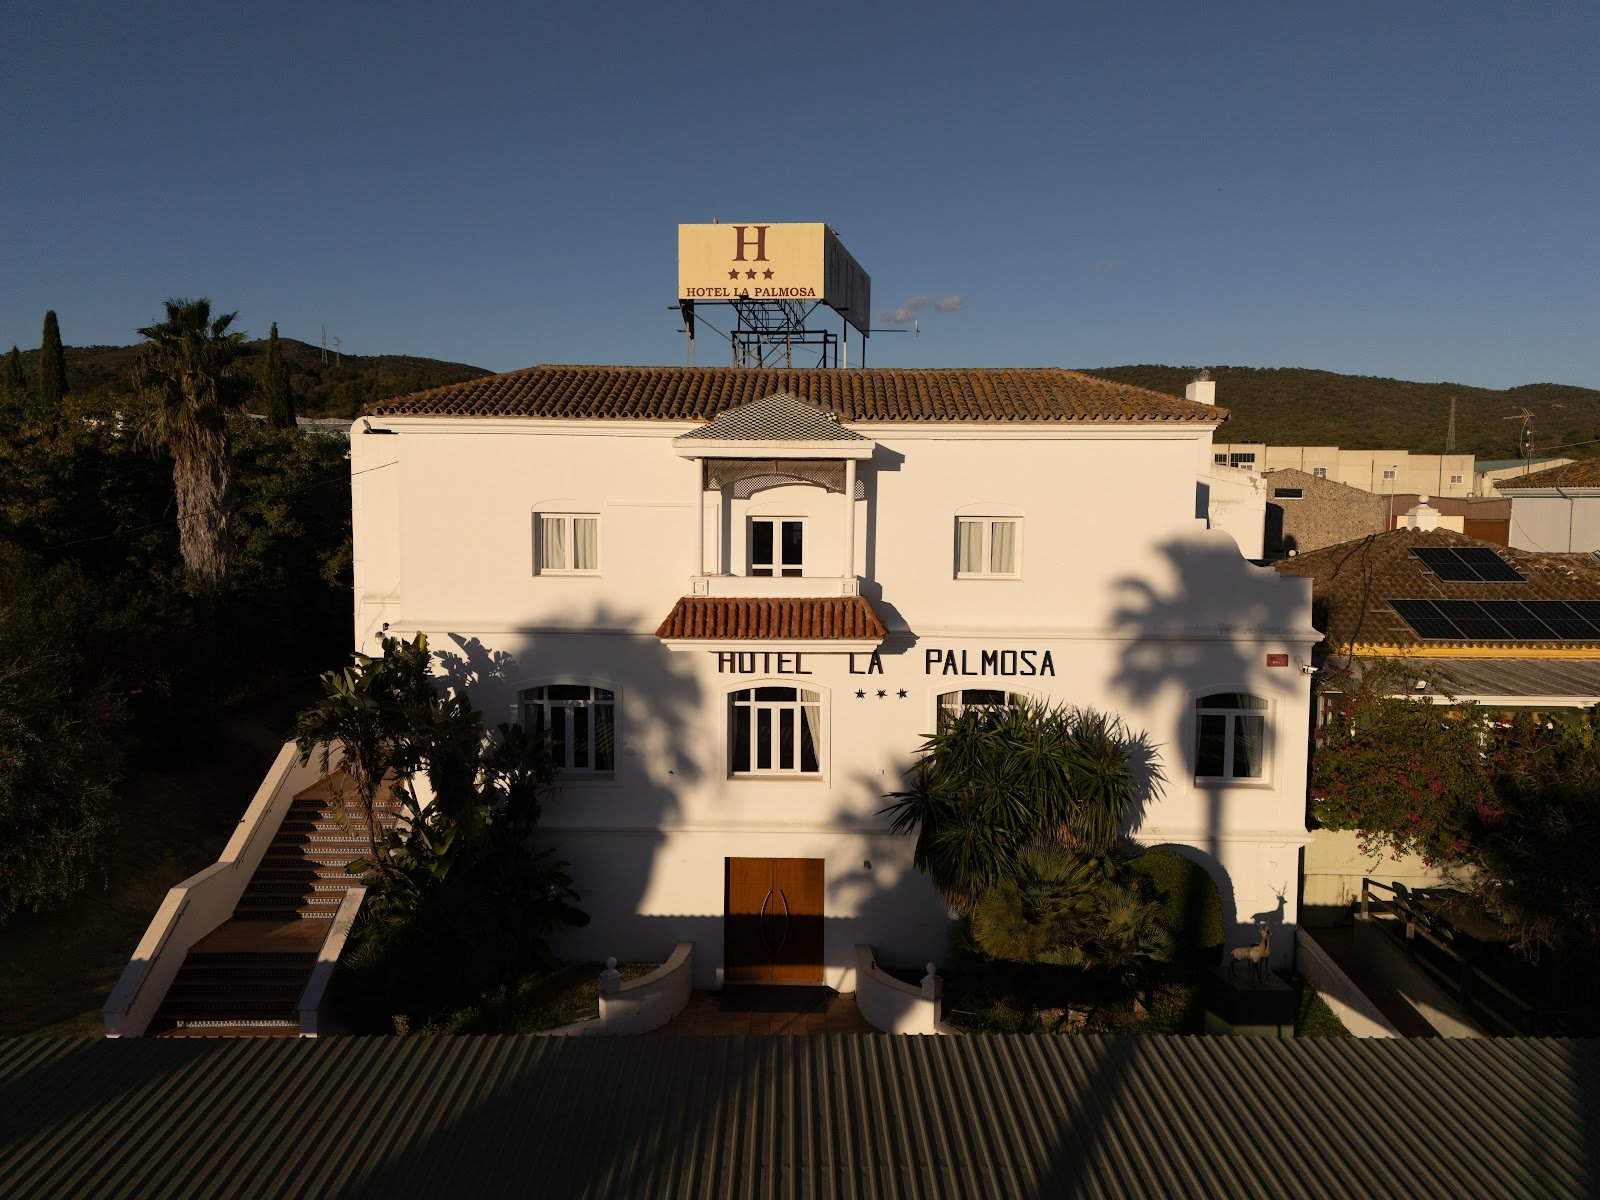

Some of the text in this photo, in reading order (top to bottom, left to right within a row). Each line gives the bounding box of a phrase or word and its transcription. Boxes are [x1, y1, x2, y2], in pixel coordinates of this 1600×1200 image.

[732, 226, 770, 262] H
[686, 287, 816, 297] HOTEL LA PALMOSA
[718, 649, 1056, 677] HOTEL LA PALMOSA
